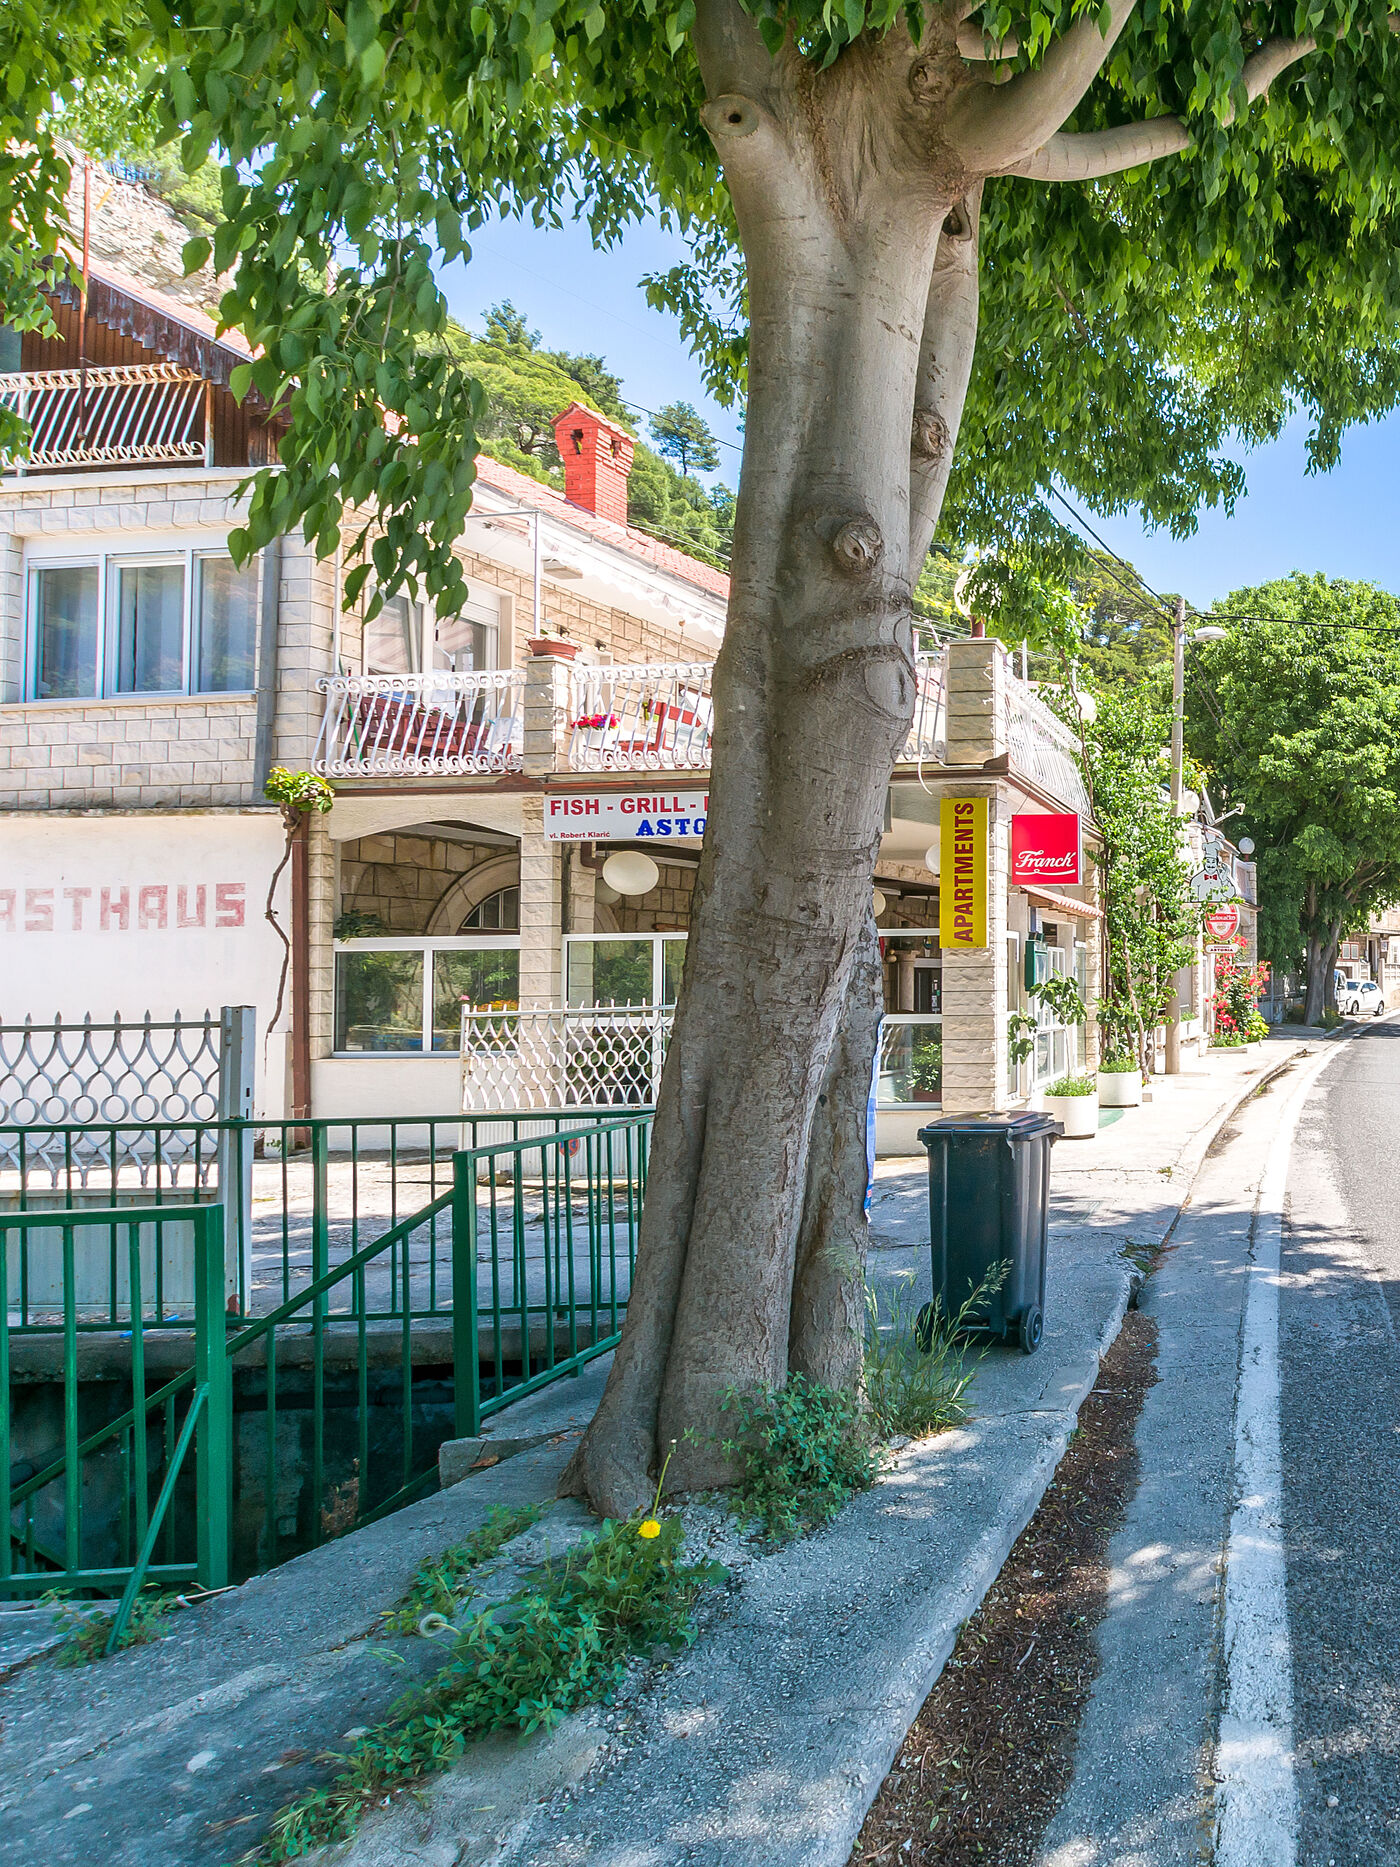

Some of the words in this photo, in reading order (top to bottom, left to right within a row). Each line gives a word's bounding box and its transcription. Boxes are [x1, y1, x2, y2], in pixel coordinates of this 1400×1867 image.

[550, 798, 600, 816] FISH
[620, 796, 685, 814] GRILL
[1015, 850, 1077, 868] Franck
[953, 802, 974, 942] APARTMENTS
